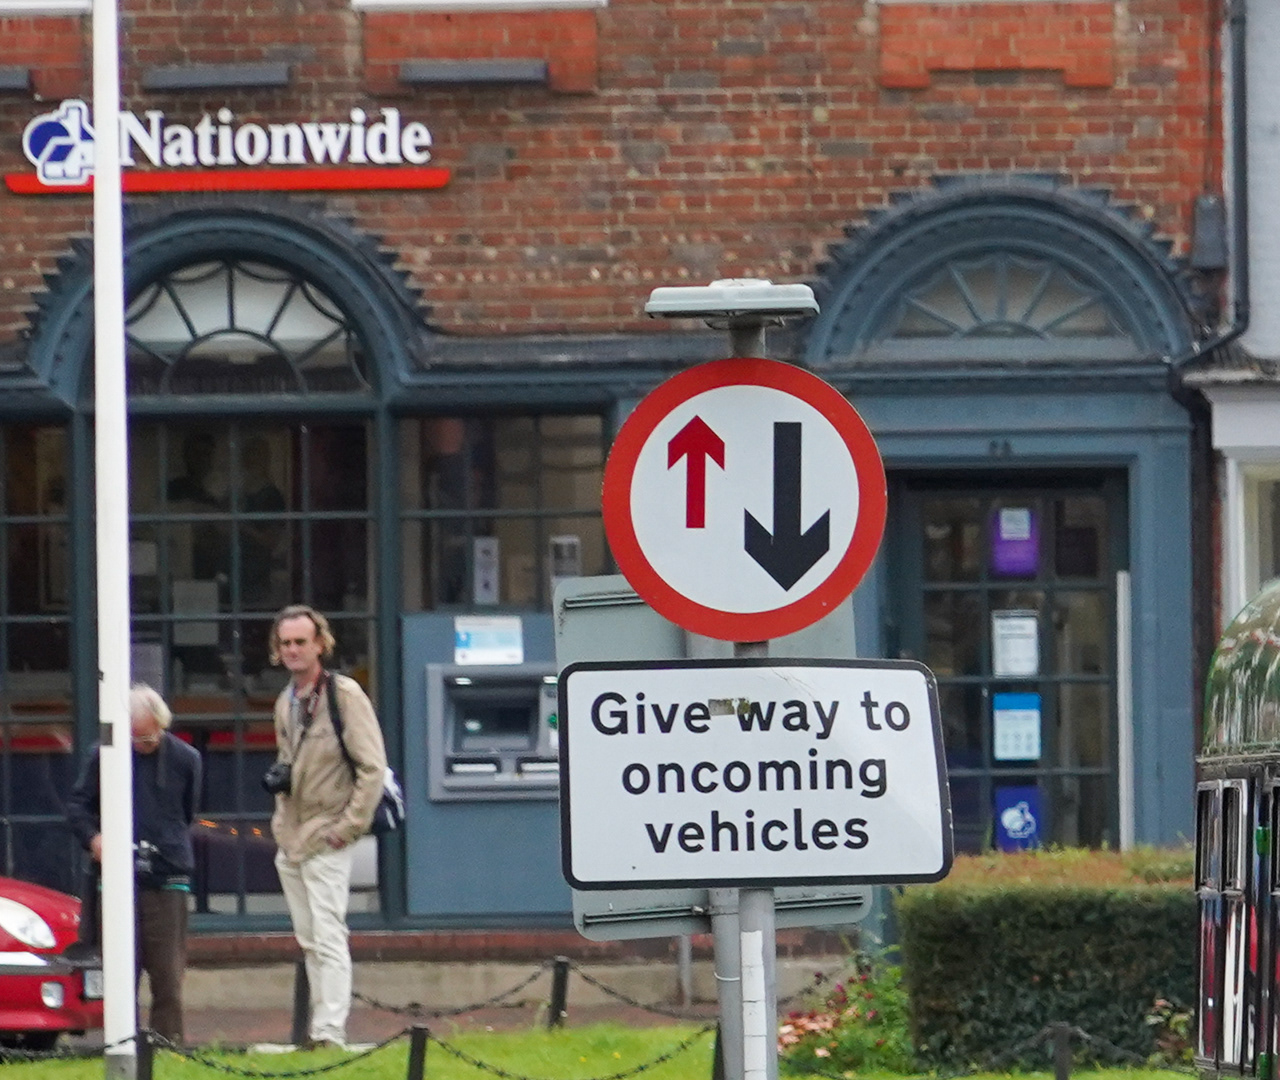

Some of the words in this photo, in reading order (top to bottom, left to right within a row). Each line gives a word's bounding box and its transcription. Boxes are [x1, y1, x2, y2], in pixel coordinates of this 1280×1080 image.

[120, 106, 432, 167] Nationwide
[591, 692, 709, 736] Give
[737, 696, 840, 740] way
[860, 691, 910, 731] to
[622, 748, 887, 799] oncoming
[645, 808, 869, 854] vehicles
